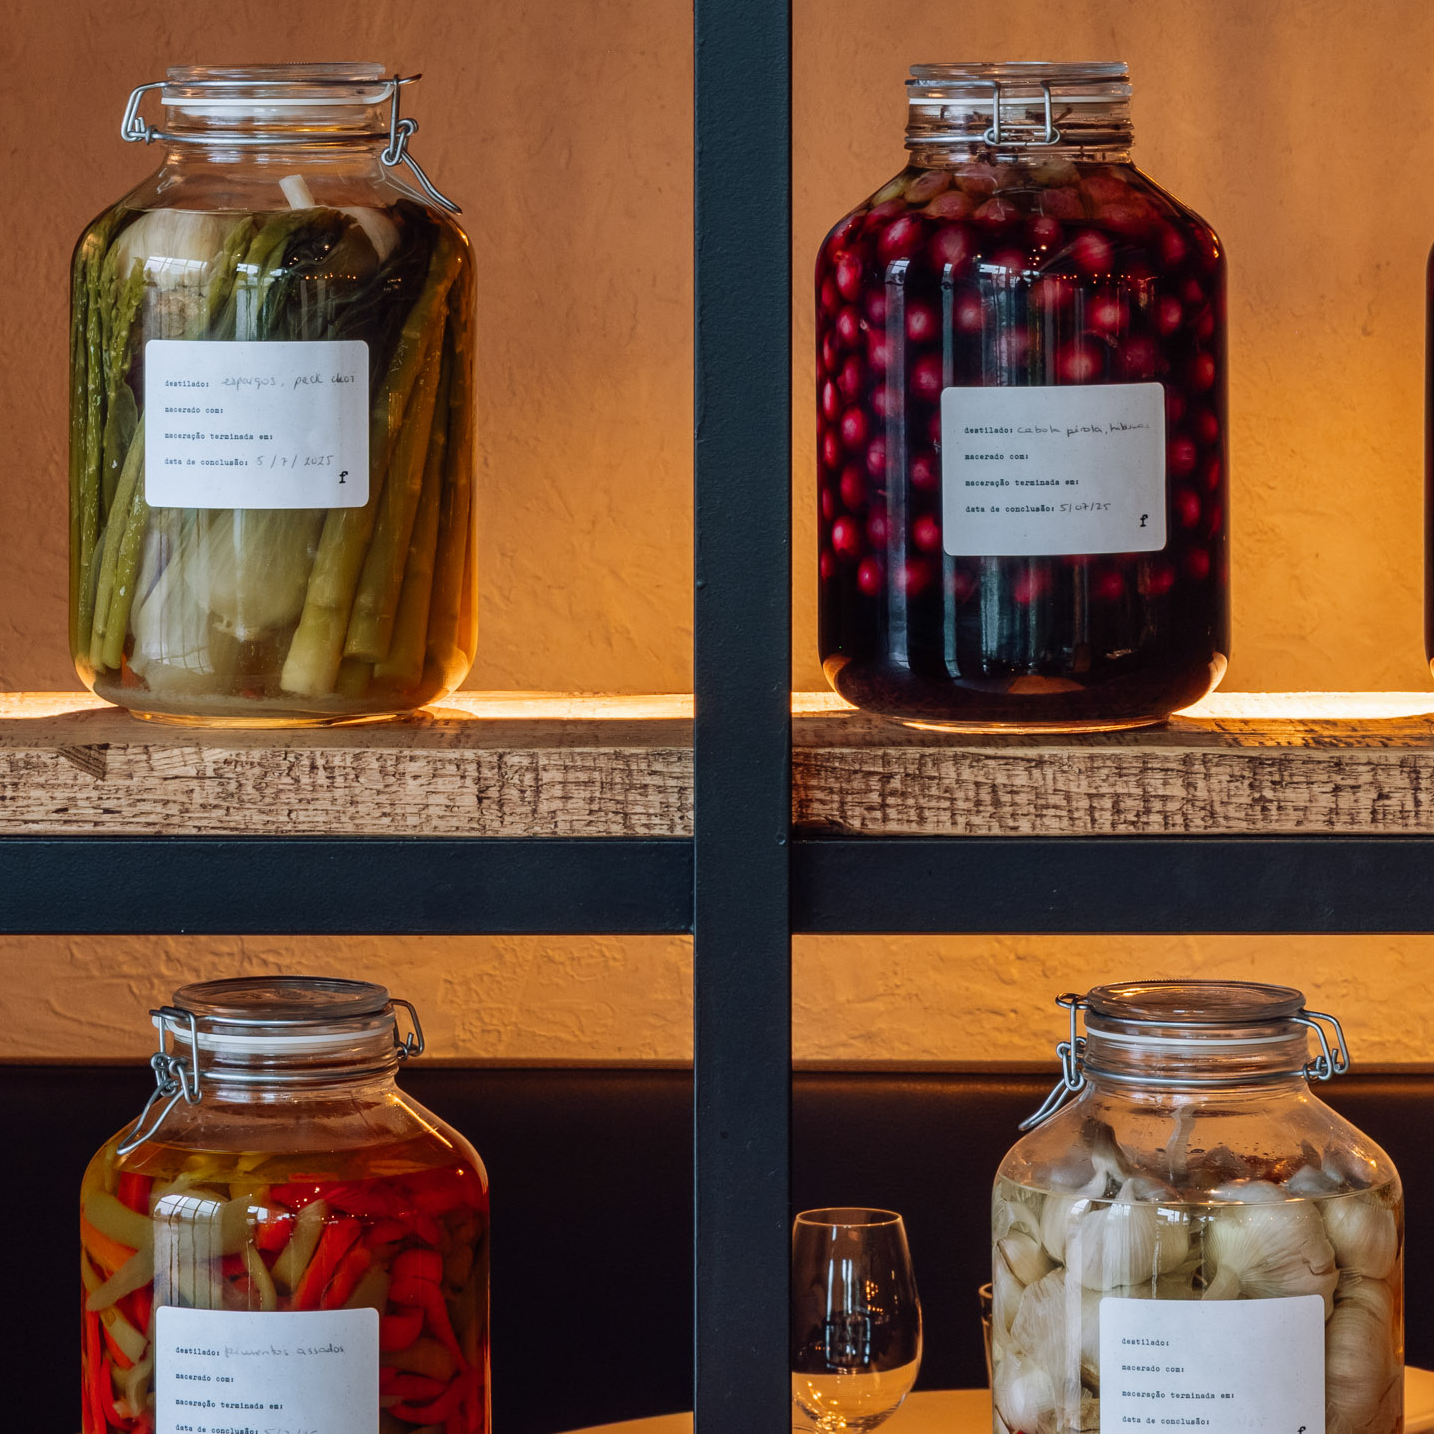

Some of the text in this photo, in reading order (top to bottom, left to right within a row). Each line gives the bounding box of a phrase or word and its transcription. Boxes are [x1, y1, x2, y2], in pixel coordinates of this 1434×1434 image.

[164, 379, 210, 388] destilado:
[164, 406, 201, 414] macerado
[963, 426, 1014, 435] destilado:
[164, 431, 206, 442] maceração
[209, 432, 255, 441] terminada
[964, 452, 1029, 461] macerado com:
[164, 457, 248, 467] data de conclusão:
[338, 470, 349, 485] f
[964, 478, 1011, 489] maceração
[1014, 478, 1061, 487] terminada
[965, 505, 986, 513] data
[989, 505, 1001, 513] de
[1004, 504, 1055, 513] conclusão:
[1139, 513, 1149, 528] f
[1121, 1337, 1170, 1347] destilado:
[174, 1346, 220, 1357] destilado:
[1121, 1364, 1185, 1374] macerado com:
[175, 1373, 212, 1382] macerado
[1121, 1390, 1166, 1400] maceração
[1169, 1391, 1216, 1400] terminada
[174, 1398, 284, 1411] maceração terminada em:
[1121, 1415, 1210, 1426] data de conclusão:
[175, 1423, 193, 1432] data
[196, 1426, 207, 1434] de
